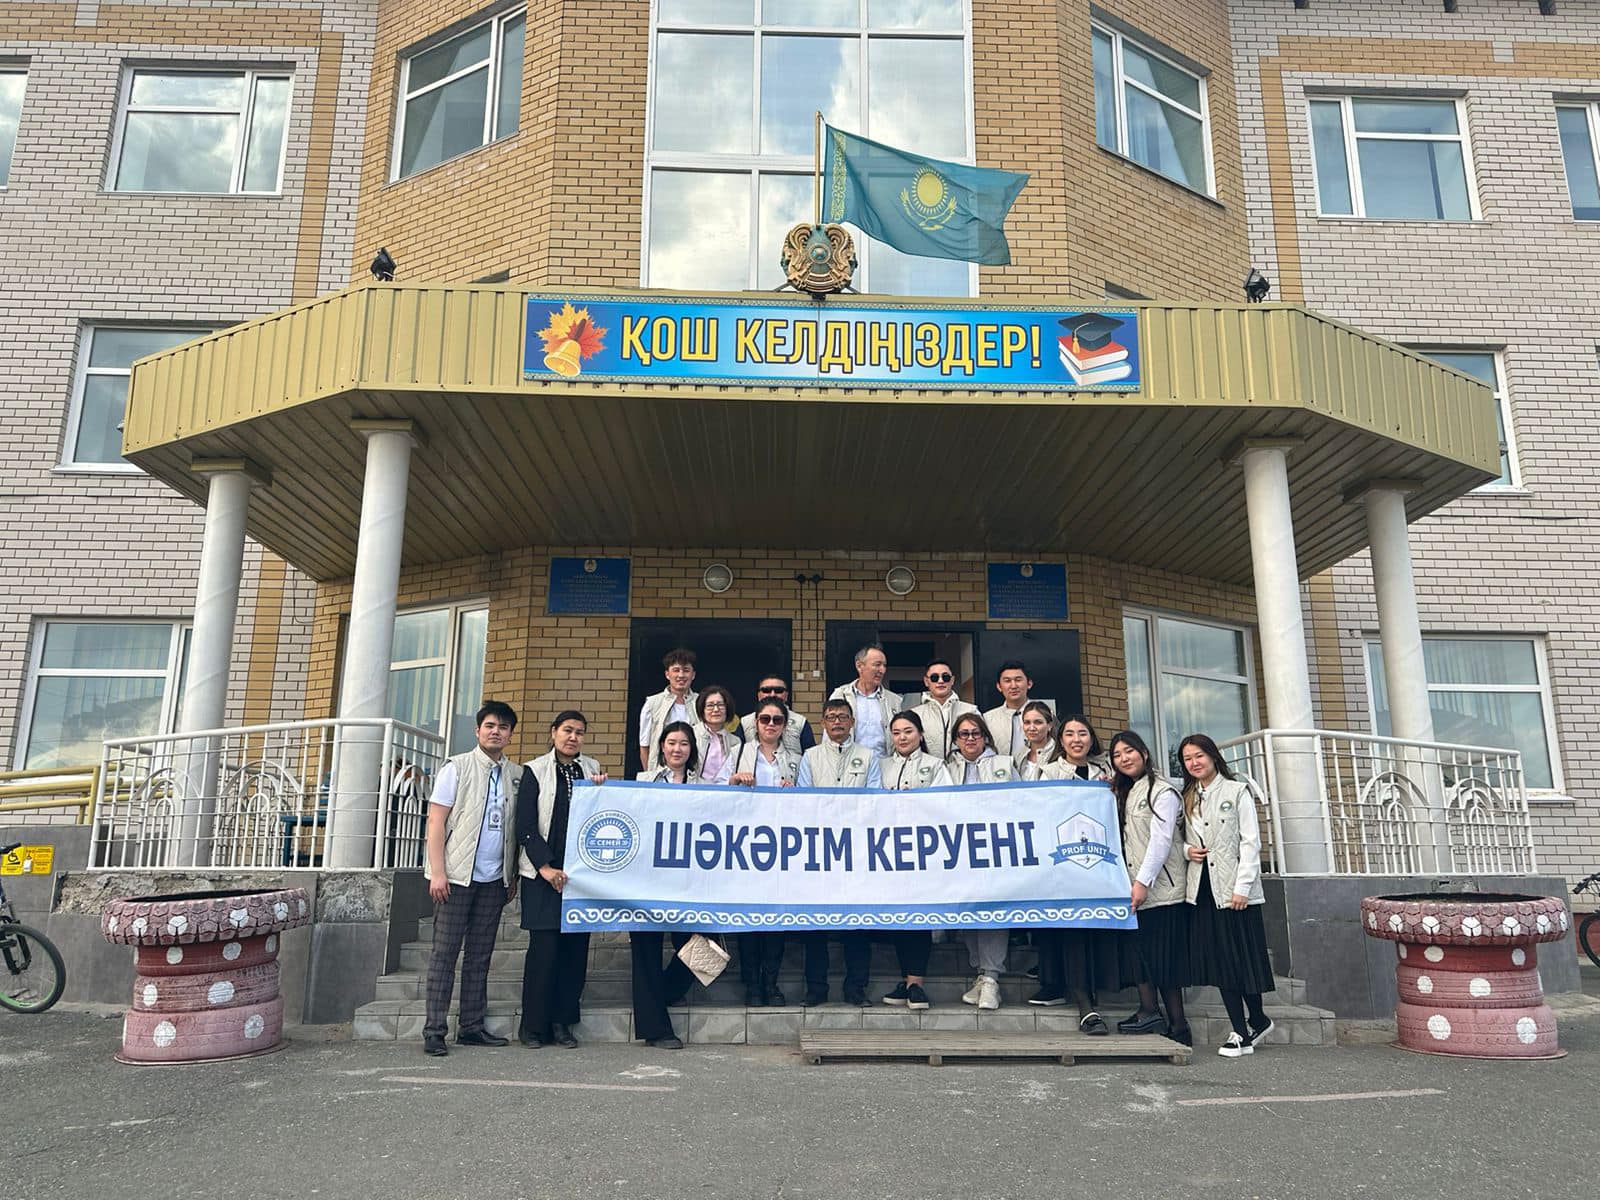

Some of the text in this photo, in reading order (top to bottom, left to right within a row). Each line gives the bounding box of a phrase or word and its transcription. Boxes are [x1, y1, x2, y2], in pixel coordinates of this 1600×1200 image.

[620, 314, 1042, 376] ҚОШ КЕЛДІҢІЗДЕР!
[653, 821, 1040, 872] ШӘКӘРІМ КЕРУЕНІ
[1061, 845, 1107, 856] PROF UNIT
